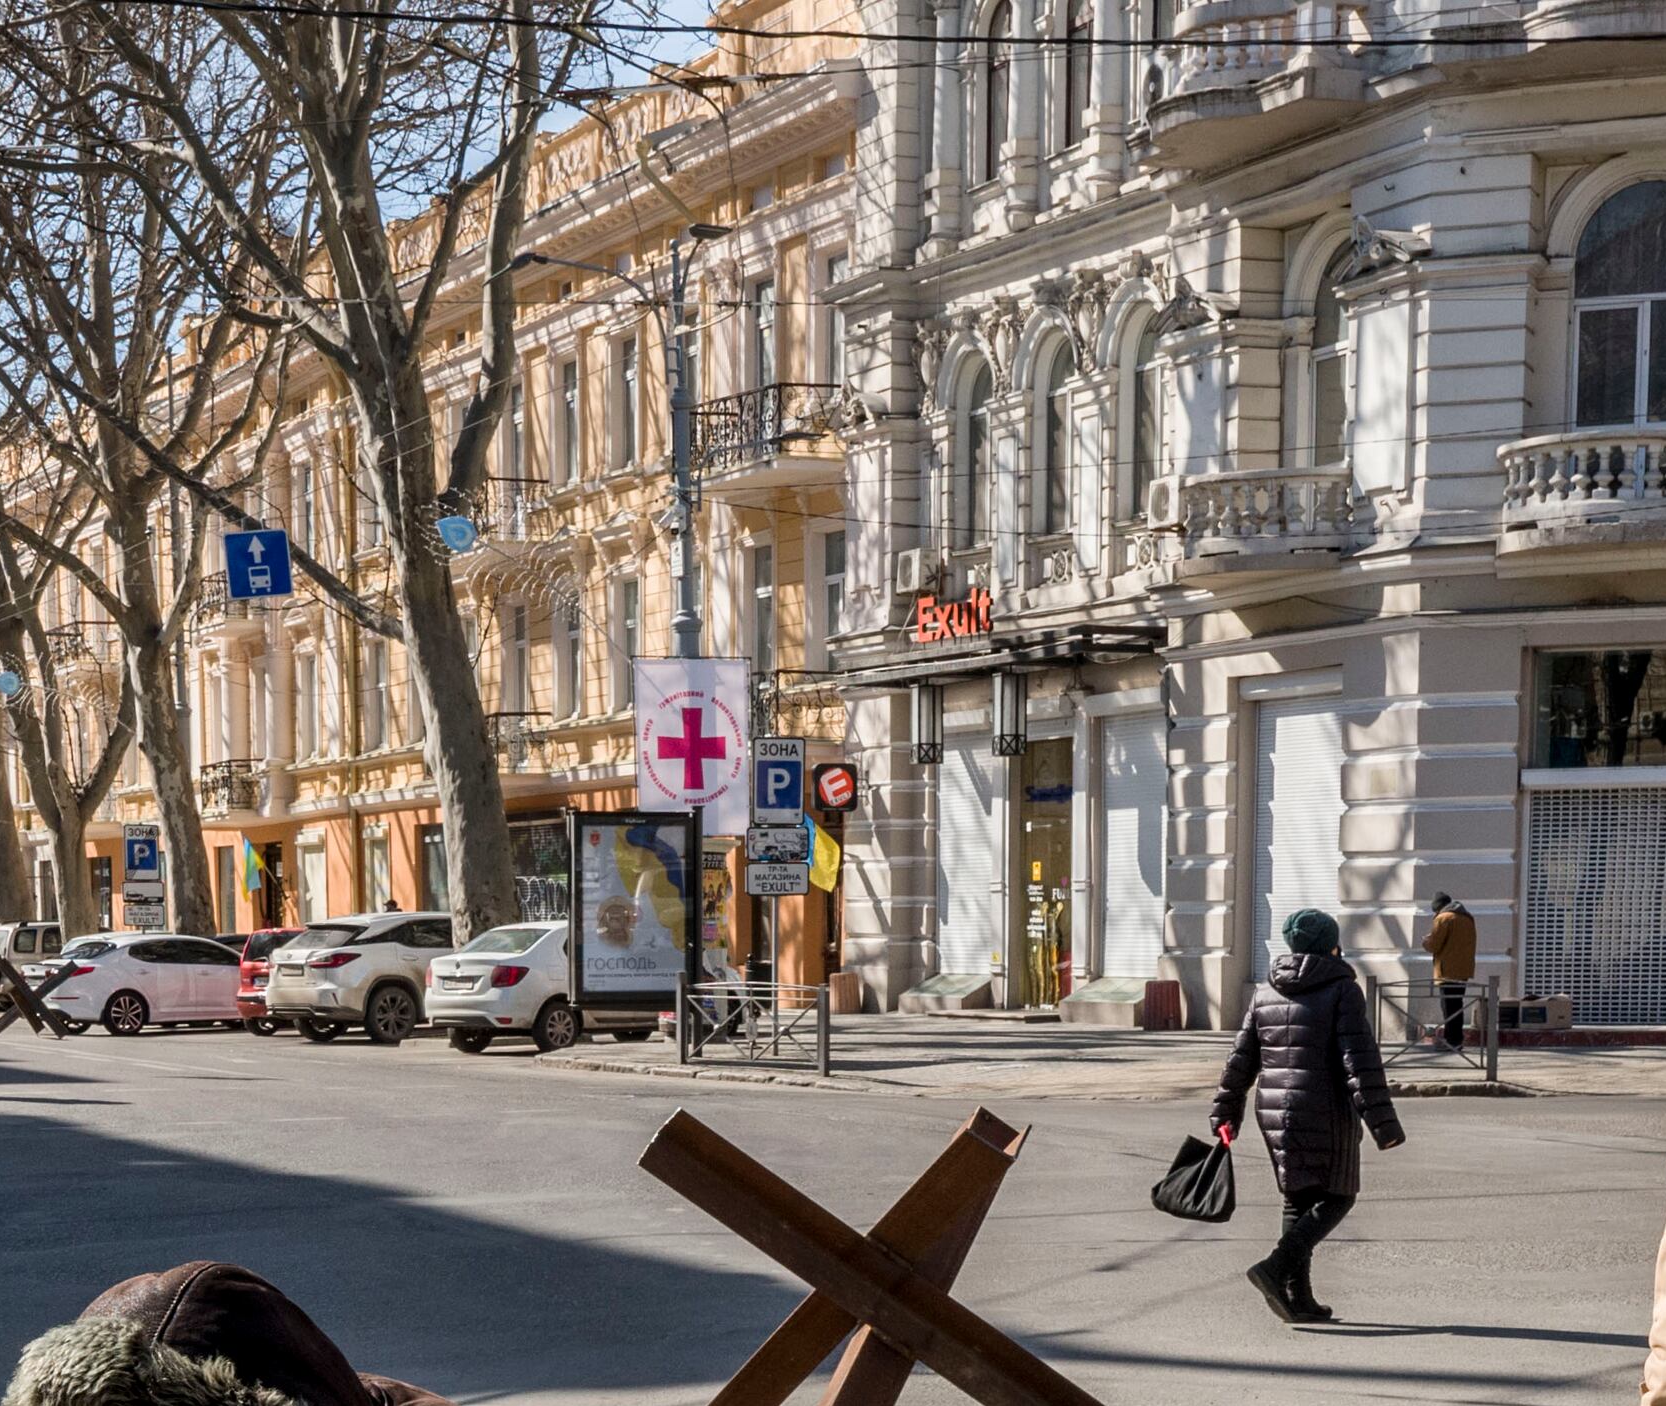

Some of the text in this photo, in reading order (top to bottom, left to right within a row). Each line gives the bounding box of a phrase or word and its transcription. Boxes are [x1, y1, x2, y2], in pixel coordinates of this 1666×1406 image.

[917, 587, 992, 643] Exult
[759, 743, 799, 757] ЗОНА
[767, 767, 791, 805] P
[754, 873, 801, 881] МАГАЗИНА
[587, 956, 658, 972] ГОСПОДЬ
